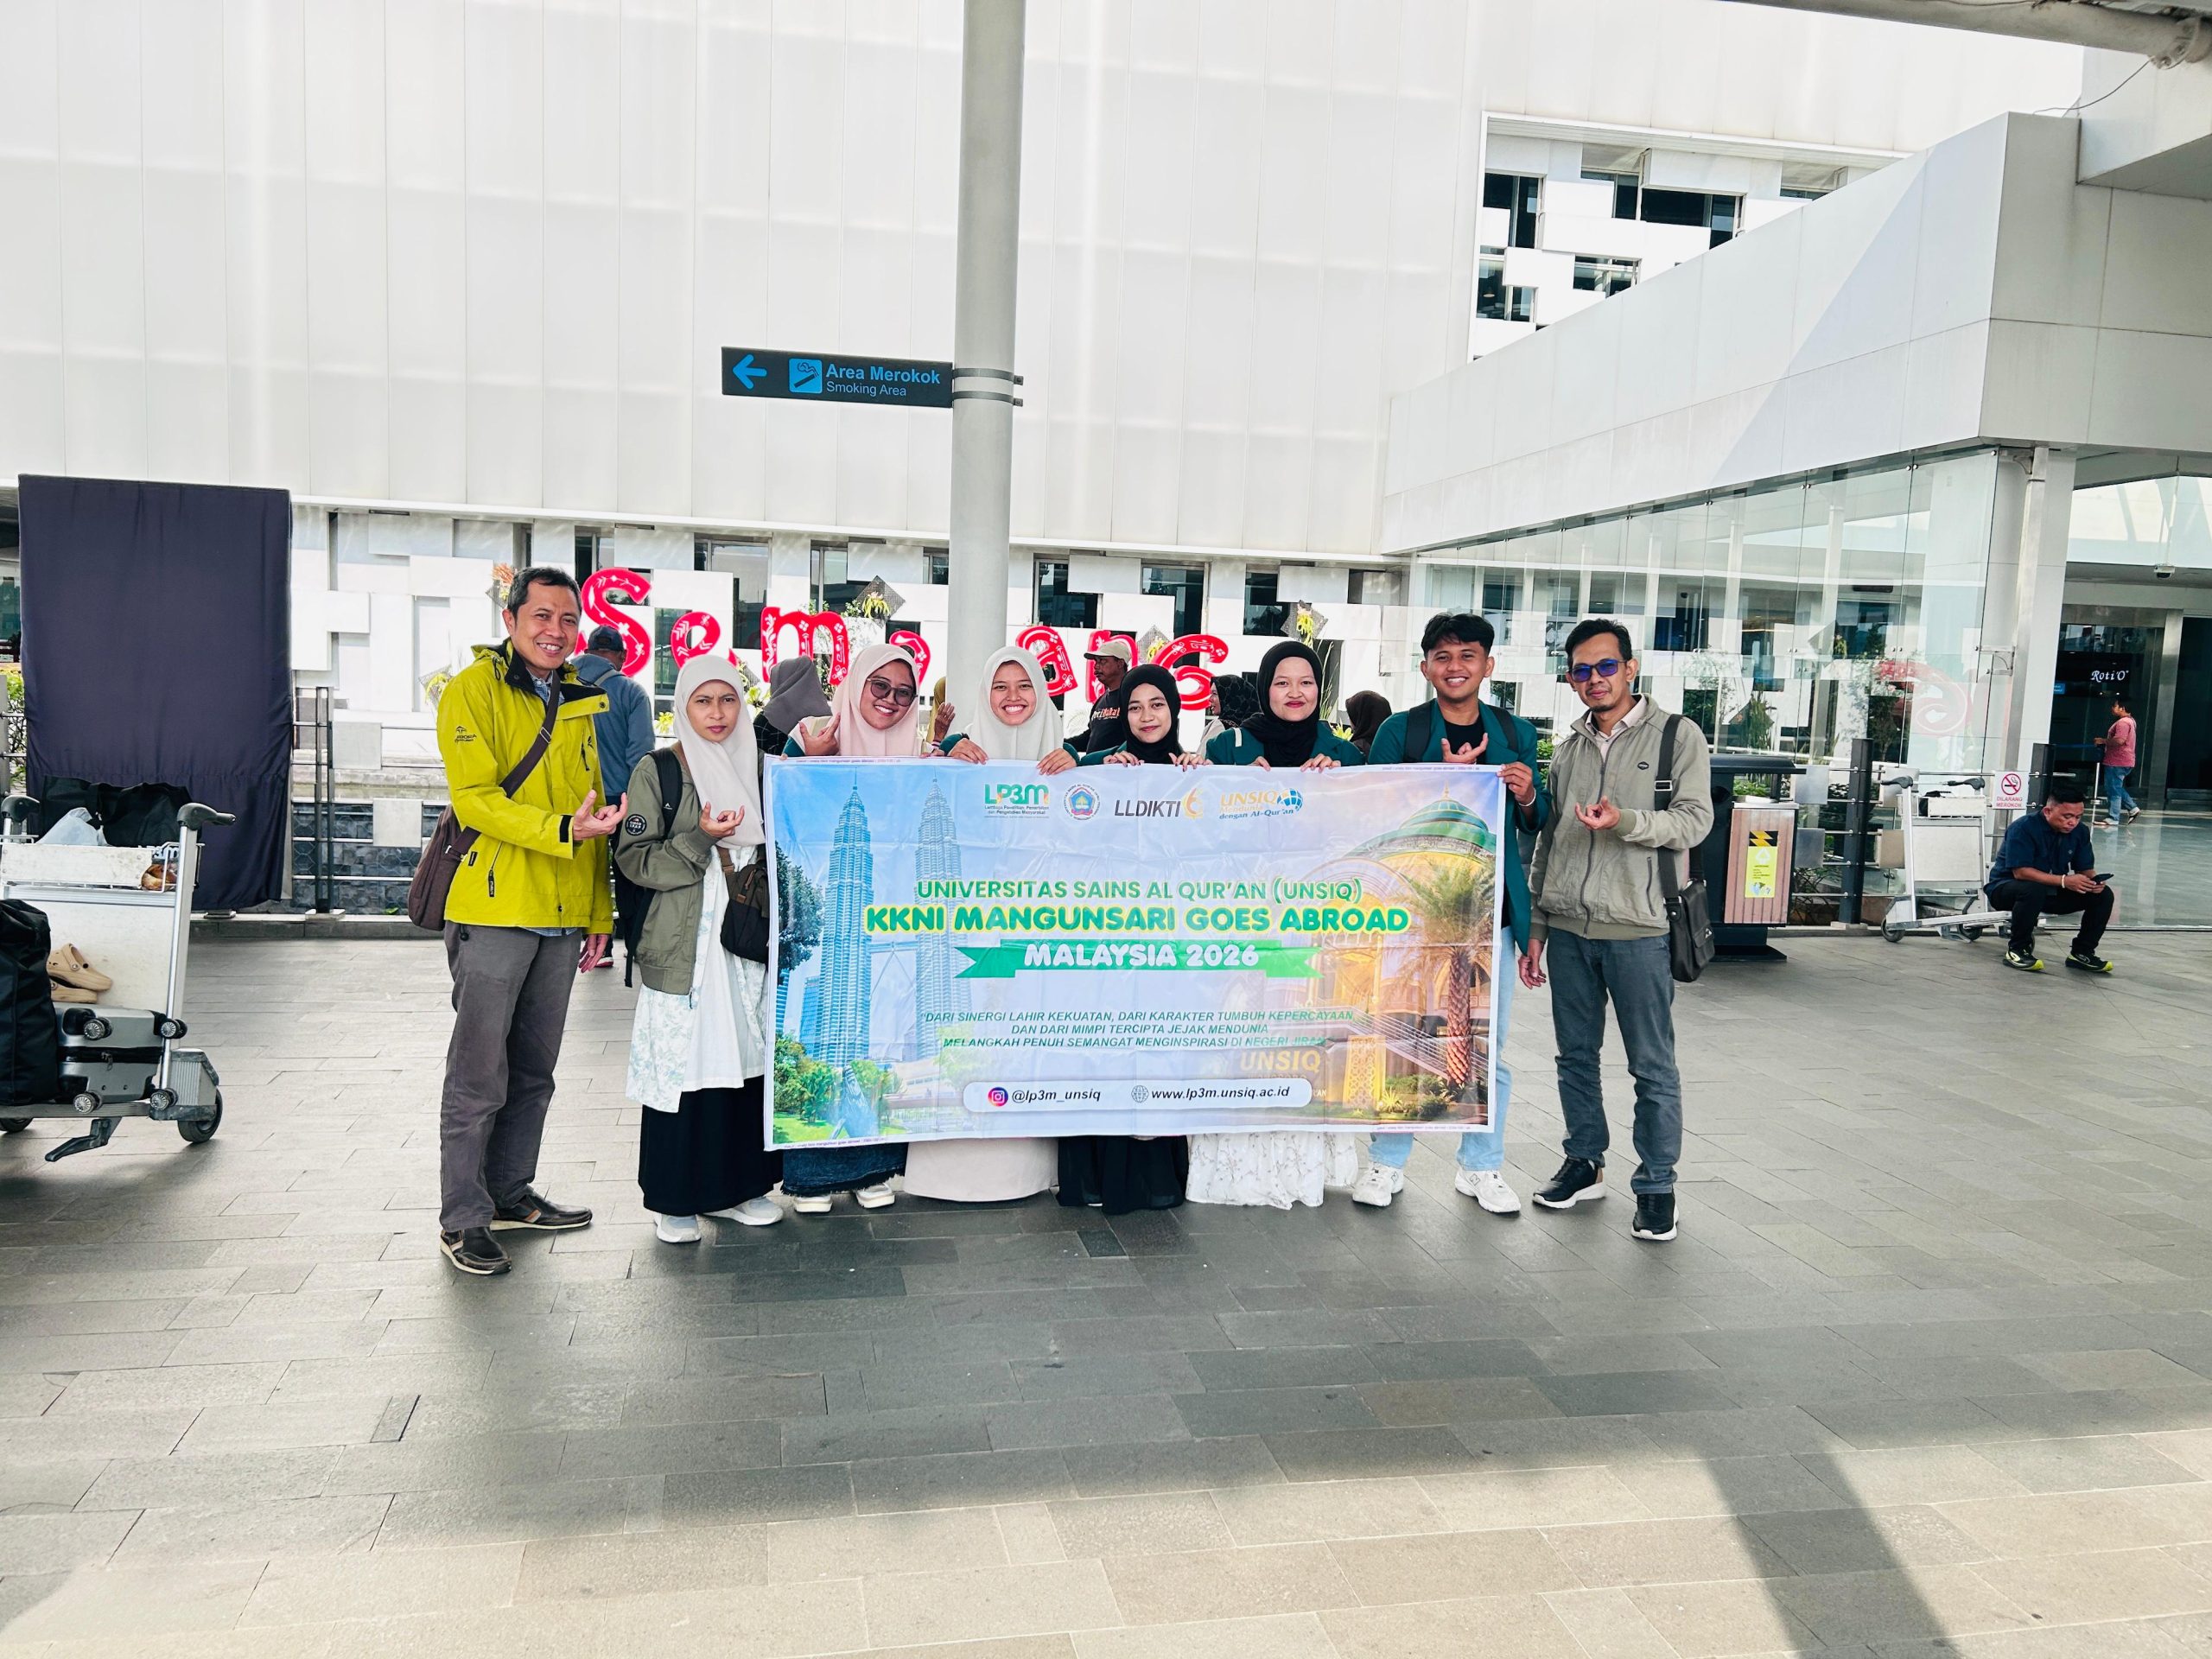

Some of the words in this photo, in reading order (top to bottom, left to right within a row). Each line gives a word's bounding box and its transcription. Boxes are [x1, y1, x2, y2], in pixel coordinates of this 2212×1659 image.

[825, 363, 865, 379] Area
[869, 365, 941, 385] Merokok
[826, 381, 877, 397] Smoking
[879, 384, 907, 397] Area
[1219, 790, 1278, 807] UNSIQ
[1114, 799, 1181, 817] LLDIKTI
[1218, 811, 1249, 820] dengan
[917, 880, 1068, 899] UNIVERSITAS
[1073, 880, 1141, 899] SAINS
[1146, 881, 1173, 899] AL
[1178, 881, 1267, 902] QUR'AN
[1272, 876, 1363, 904] (UNSIQ)
[866, 906, 945, 931] KKNI
[953, 906, 1176, 931] MANGUNSARI
[1185, 907, 1271, 931] GOES
[1279, 907, 1409, 931] ABROAD
[1023, 943, 1178, 967] MALAYSIA
[1185, 944, 1260, 967] 2026
[957, 1012, 1007, 1022] SINERGI
[1008, 1011, 1045, 1021] LAHIR
[1047, 1011, 1115, 1023] KEKUATAN,
[1117, 1011, 1147, 1021] DARI
[1148, 1011, 1214, 1021] KARAKTER
[1217, 1010, 1267, 1021] TUMBUH
[1011, 1024, 1038, 1034] DAN
[1039, 1024, 1069, 1034] DARI
[1071, 1024, 1106, 1034] MIMPI
[1109, 1024, 1165, 1034] TERCIPTA
[1167, 1024, 1205, 1034] JEJAK
[1209, 1024, 1268, 1034] MENDUNIA
[943, 1038, 1020, 1047] MELANGKAH
[1022, 1037, 1064, 1047] PENUH
[1067, 1037, 1131, 1047] SEMANGAT
[1135, 1036, 1229, 1047] MENGINSPIRASI
[1230, 1037, 1243, 1046] DI
[1244, 1036, 1288, 1046] NEGERI
[1239, 1050, 1322, 1073] UNSIQ
[1011, 1089, 1102, 1103] @lp3m_unsiq
[1151, 1086, 1290, 1101] www.lp3m.unsiq.ac.id
